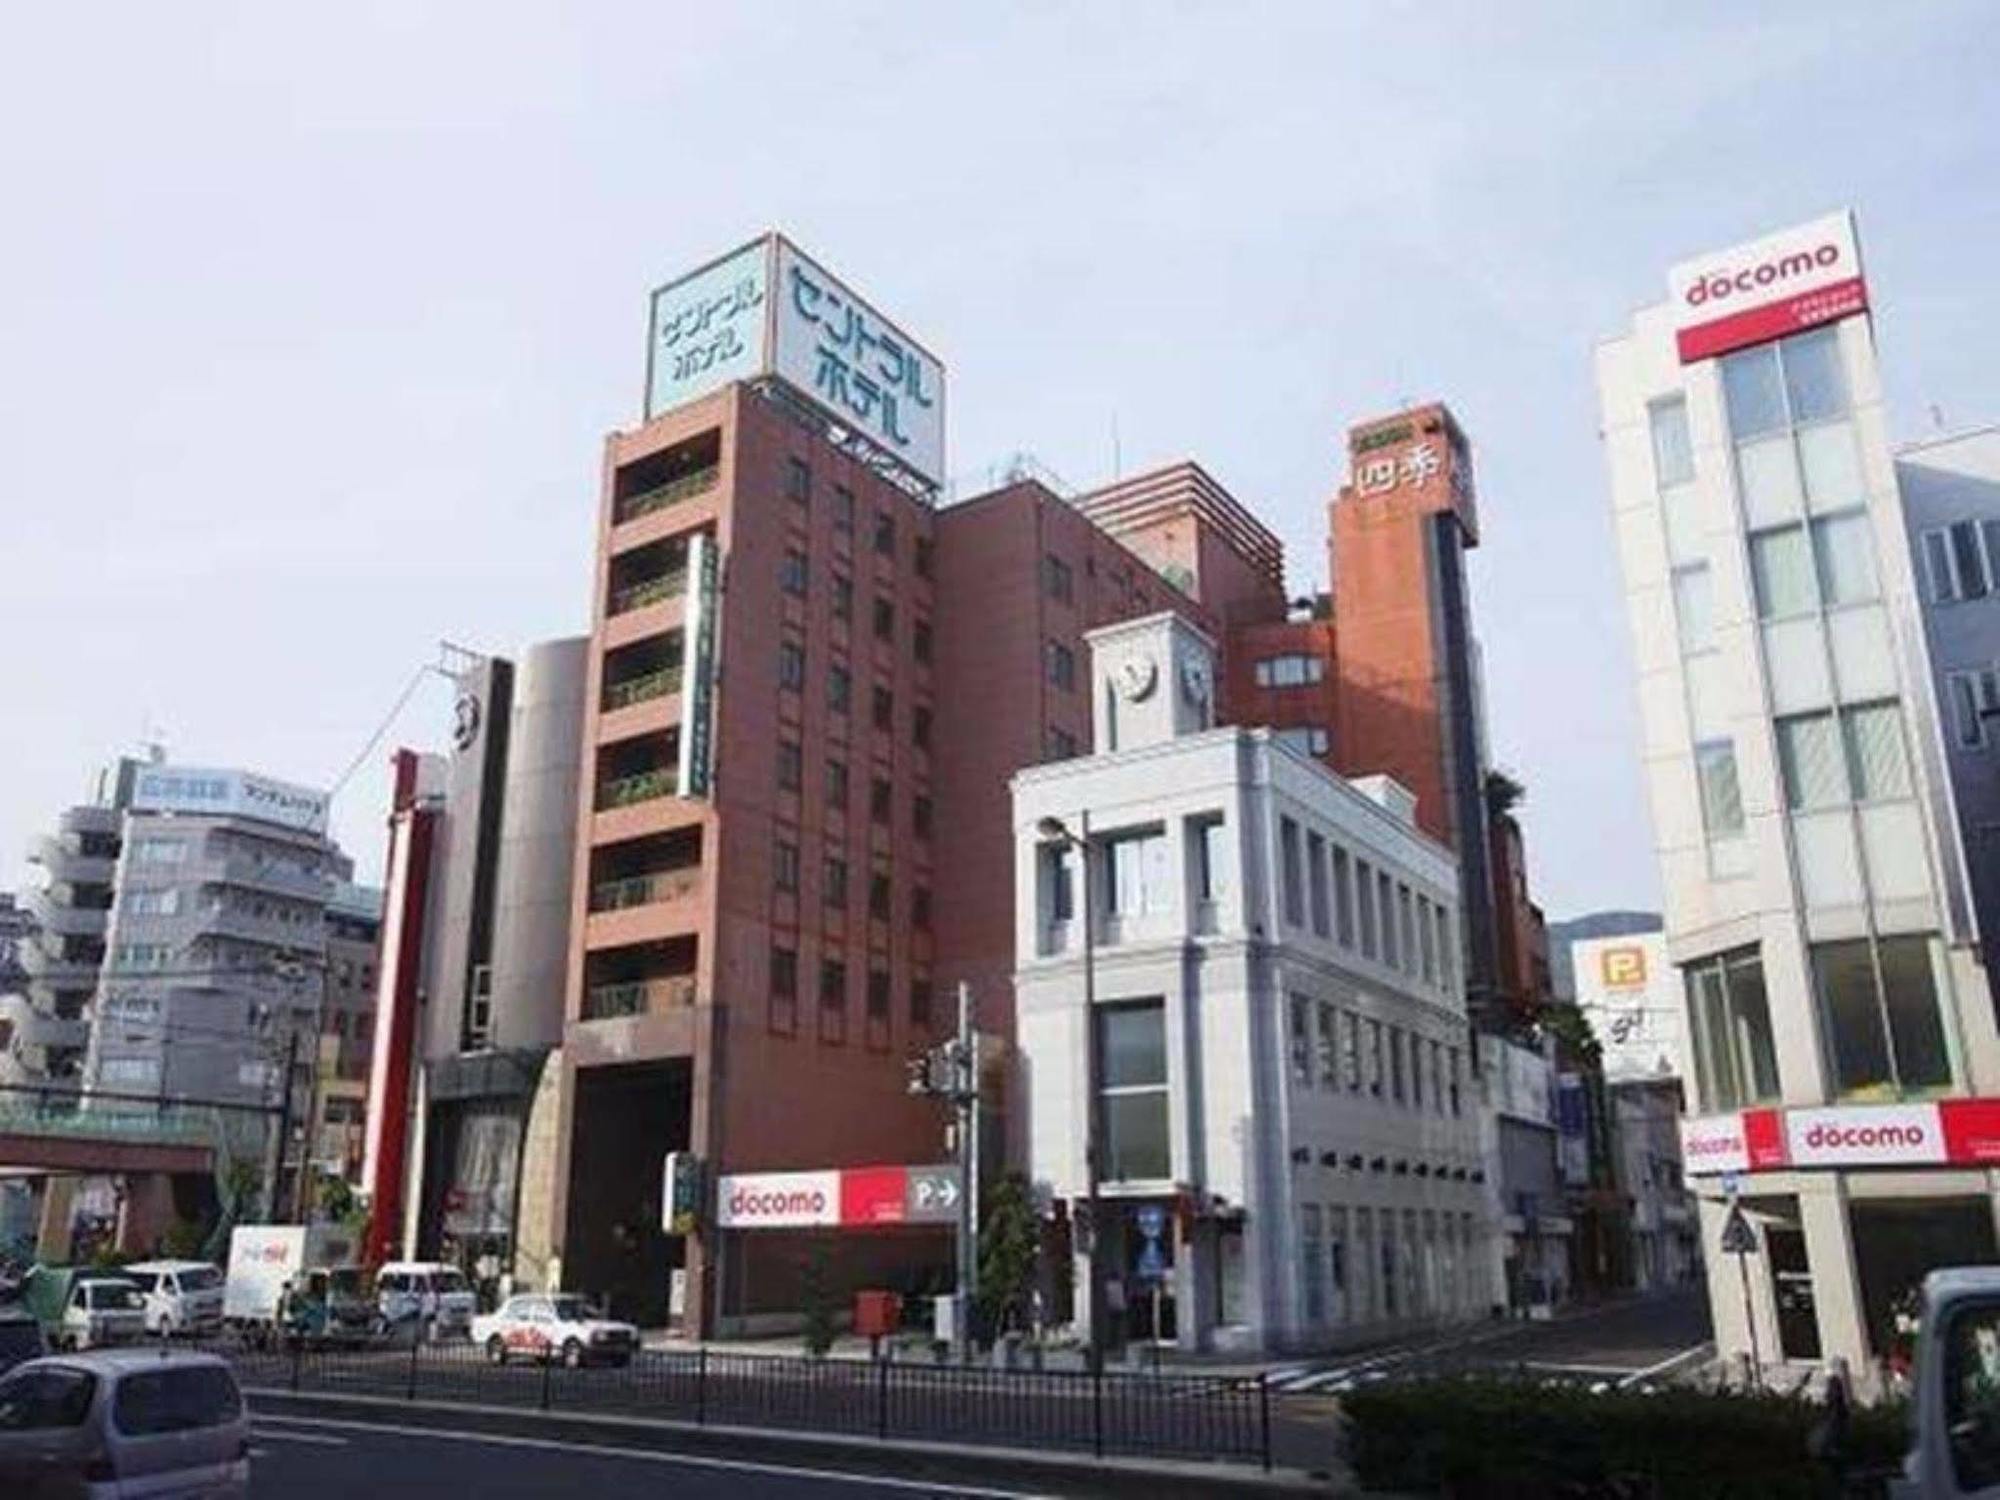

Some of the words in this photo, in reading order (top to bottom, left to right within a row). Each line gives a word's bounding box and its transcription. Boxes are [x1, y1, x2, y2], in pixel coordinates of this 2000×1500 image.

[1686, 244, 1839, 305] docomo
[791, 266, 932, 408] セントラル
[816, 343, 910, 445] ホテル
[1806, 1122, 1924, 1149] docomo
[729, 1187, 825, 1215] docomo
[916, 1181, 933, 1205] P
